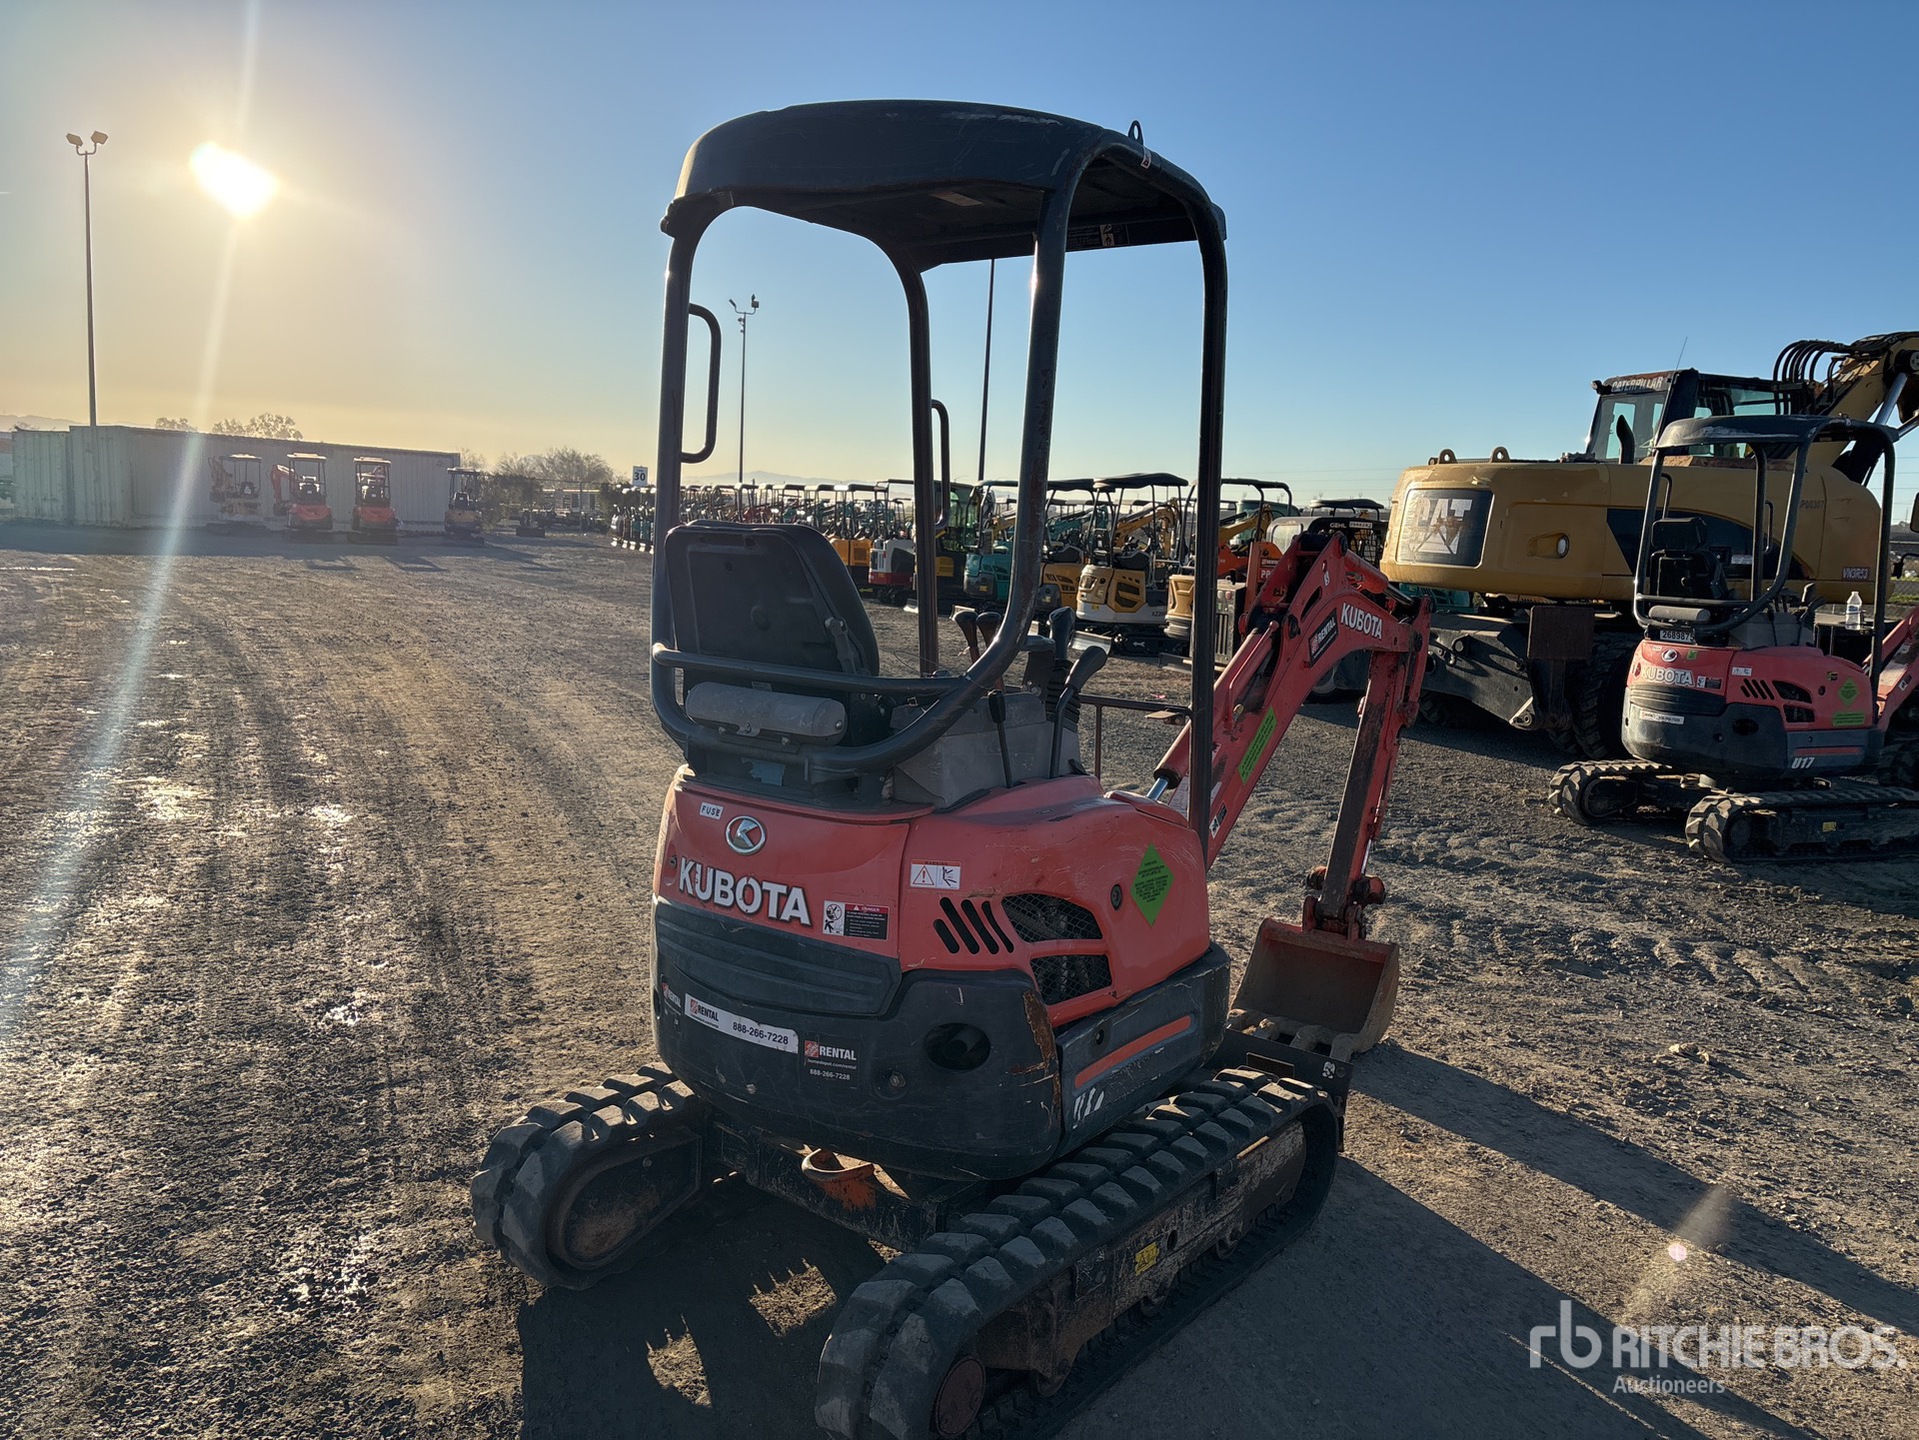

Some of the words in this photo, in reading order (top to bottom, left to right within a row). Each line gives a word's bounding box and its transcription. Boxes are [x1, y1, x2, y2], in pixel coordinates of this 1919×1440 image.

[1611, 376, 1664, 392] CATERPILLAR
[634, 472, 646, 482] 30
[1408, 496, 1473, 555] CAT
[1340, 602, 1383, 640] KUBOTA
[1662, 630, 1695, 642] 2689875
[1641, 666, 1695, 687] KUBOTA
[1791, 756, 1816, 770] U17
[701, 806, 721, 817] FUSE
[679, 856, 812, 926] KUBOTA
[697, 1004, 719, 1022] RENTAL
[732, 1021, 789, 1046] 888-266-7228
[818, 1045, 858, 1061] RENTAL
[809, 1068, 851, 1081] 888-266-7228
